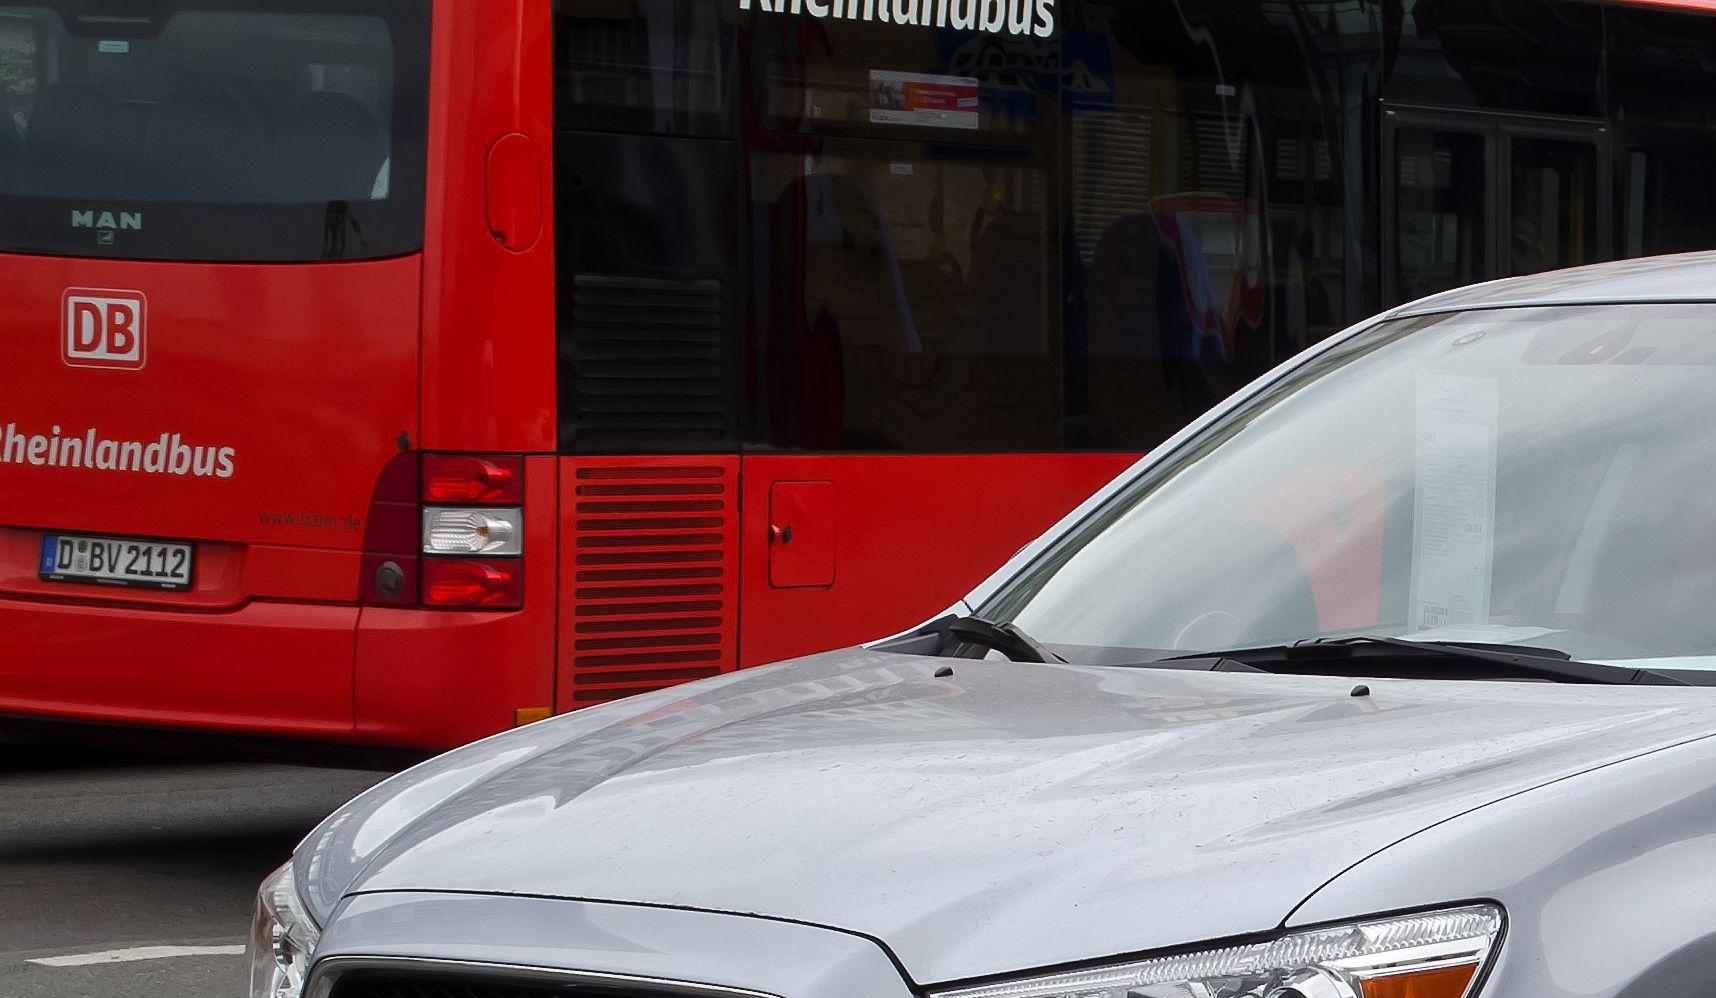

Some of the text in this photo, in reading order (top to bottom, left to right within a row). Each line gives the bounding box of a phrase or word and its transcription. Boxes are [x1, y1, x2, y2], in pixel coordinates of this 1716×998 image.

[739, 0, 1054, 37] andbus
[71, 210, 142, 230] MAN
[73, 301, 135, 355] DB
[0, 422, 236, 478] heinlandbus
[57, 539, 185, 578] D BV 2112
